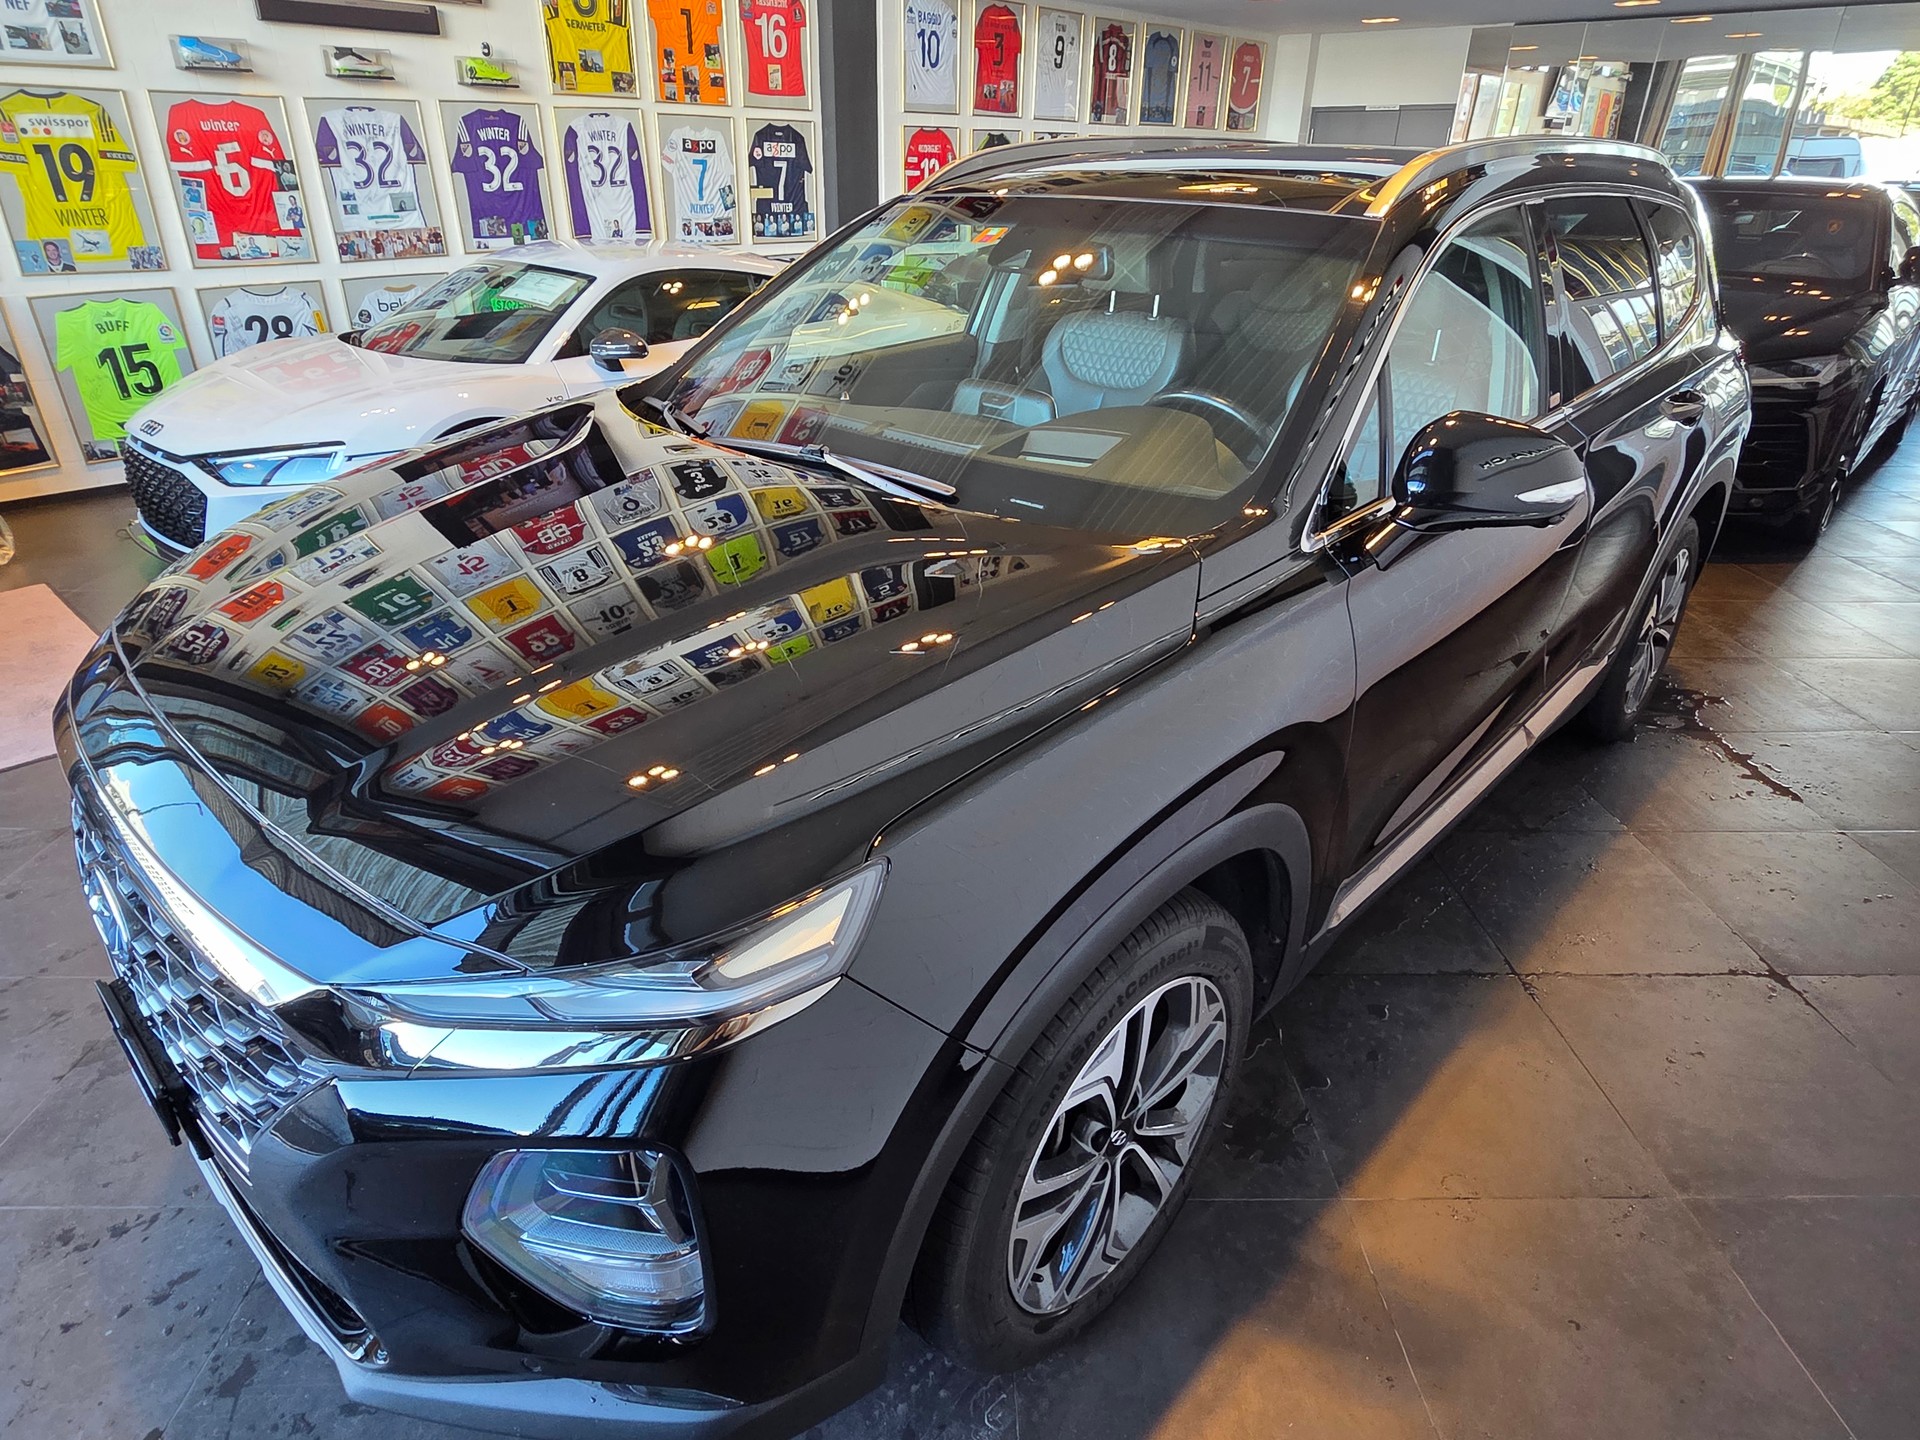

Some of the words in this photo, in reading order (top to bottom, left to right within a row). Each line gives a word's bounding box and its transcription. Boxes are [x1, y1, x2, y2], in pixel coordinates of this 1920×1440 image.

[680, 8, 693, 55] 1
[755, 13, 787, 59] 16
[917, 28, 940, 68] 10
[1054, 36, 1064, 68] 9
[1109, 44, 1117, 71] 8
[1199, 61, 1211, 91] 11
[1243, 66, 1250, 95] 7
[28, 116, 90, 128] swisspor
[200, 119, 240, 132] winter
[346, 123, 385, 137] WINTER
[476, 127, 510, 141] WINTER
[587, 130, 616, 143] WINTER
[32, 143, 95, 203] 19
[214, 141, 251, 197] 6
[345, 141, 401, 189] 32
[478, 146, 524, 192] 32
[587, 144, 627, 188] 32
[692, 158, 708, 201] 7
[774, 161, 787, 200] 7
[54, 208, 109, 227] WINTER
[690, 203, 715, 214] WINTER
[771, 203, 793, 213] WINTER
[95, 320, 130, 335] BUFF
[244, 315, 294, 344] 28
[97, 343, 164, 401] 15
